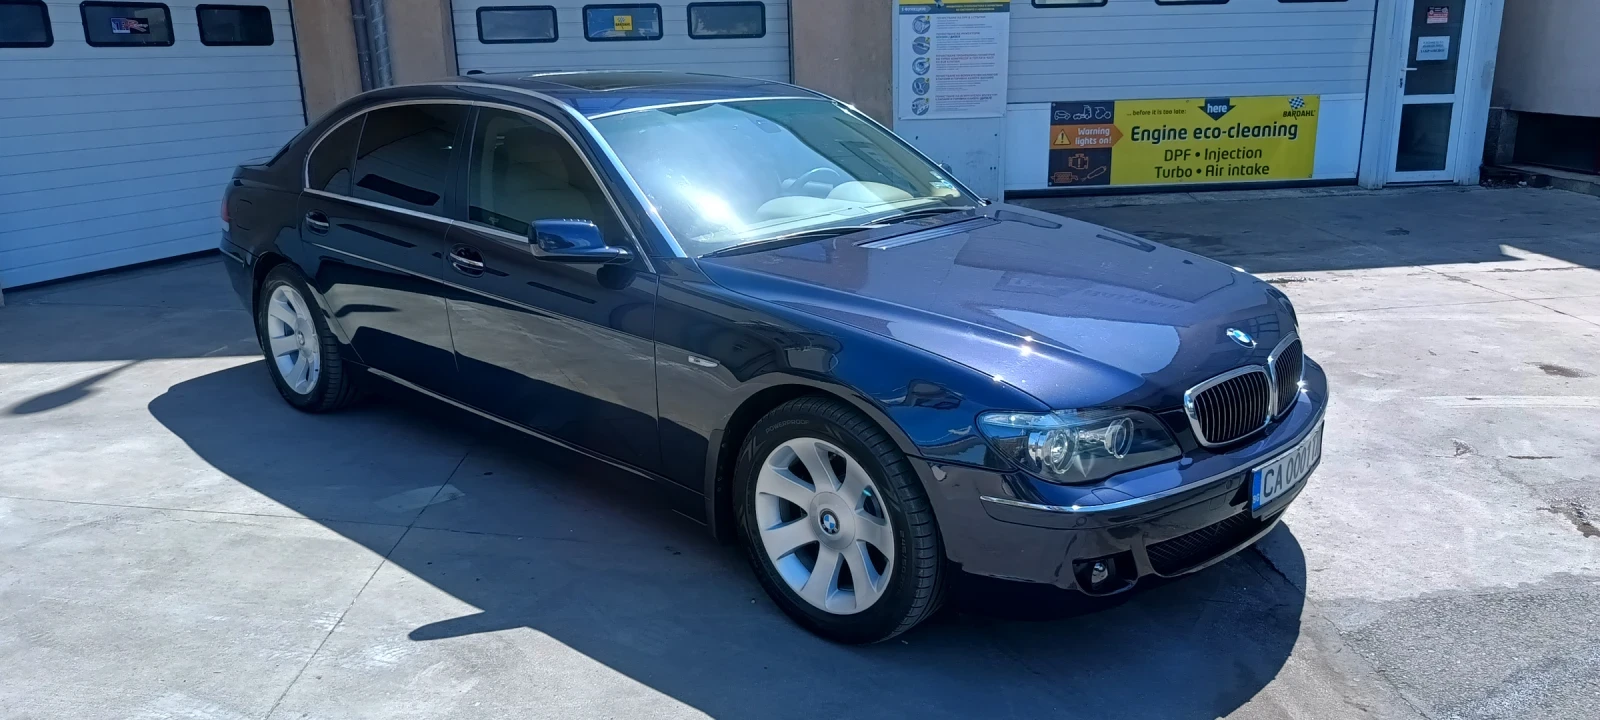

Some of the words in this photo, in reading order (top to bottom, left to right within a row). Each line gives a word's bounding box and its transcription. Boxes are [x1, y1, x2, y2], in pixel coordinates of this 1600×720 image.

[1207, 103, 1228, 113] here
[1282, 109, 1315, 119] BARDAHL
[1078, 127, 1110, 136] Warning
[1131, 124, 1188, 145] Engine
[1193, 121, 1298, 140] eco-cleaning
[1075, 137, 1097, 146] lights
[1164, 149, 1192, 161] DPF
[1204, 146, 1263, 162] Injection
[1154, 166, 1193, 178] Turbo
[1205, 164, 1225, 177] Air
[1228, 163, 1270, 176] intake
[764, 419, 810, 434] POWERPROOF
[1263, 464, 1283, 498] CA
